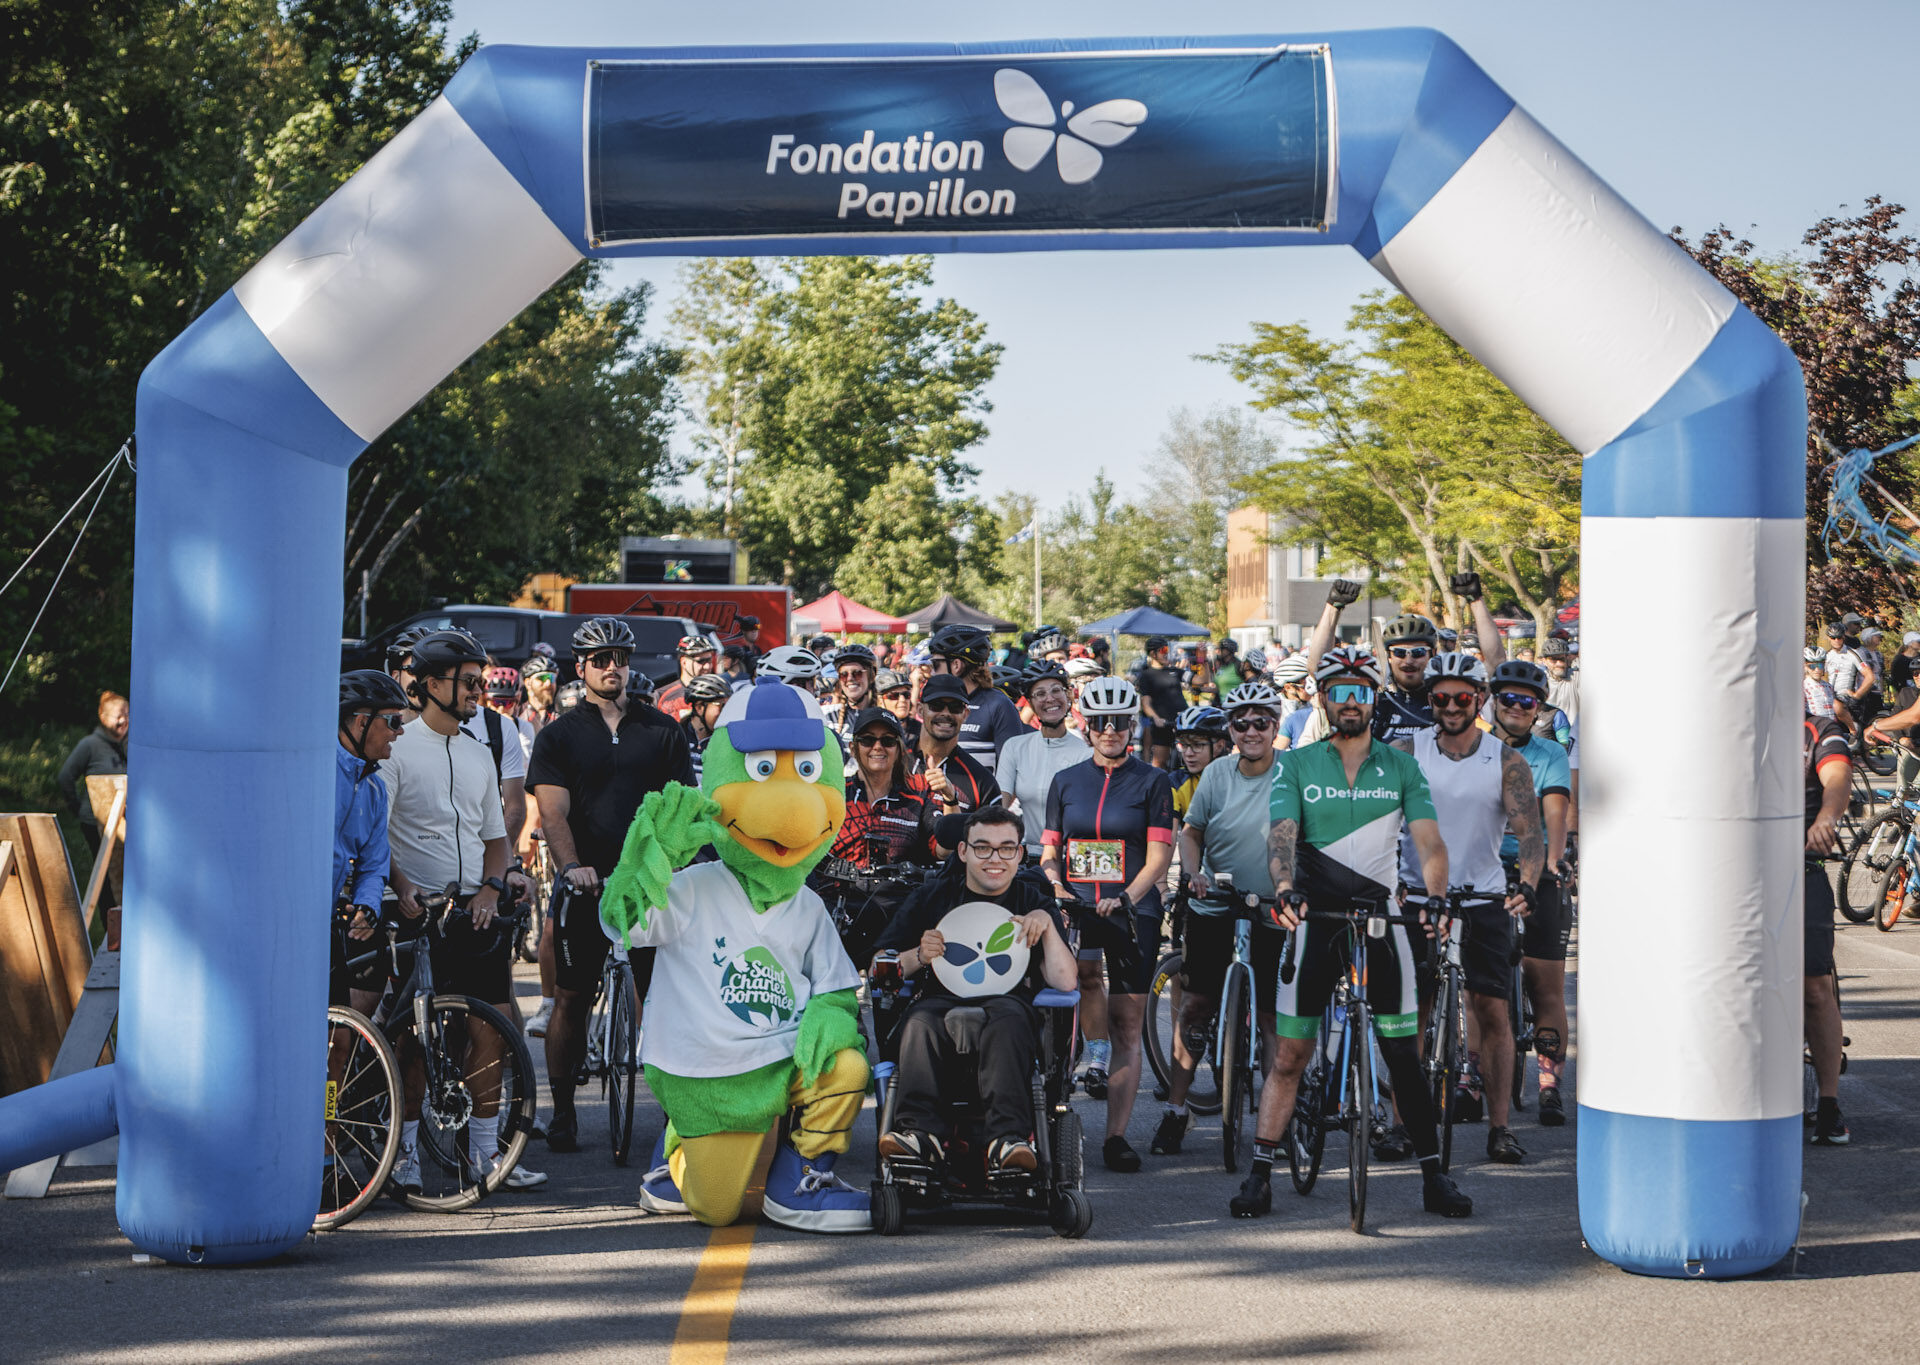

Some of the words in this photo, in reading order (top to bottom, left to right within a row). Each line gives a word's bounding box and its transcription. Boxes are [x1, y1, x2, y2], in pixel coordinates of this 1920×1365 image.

[766, 129, 984, 175] Fondation
[837, 179, 1016, 226] Papillon
[663, 560, 692, 580] K
[1325, 786, 1399, 800] Desjardins
[1075, 854, 1112, 874] 316
[750, 959, 785, 984] Saint
[729, 973, 786, 996] Charles
[720, 985, 793, 1011] Borromée
[327, 1086, 336, 1118] VEVOR
